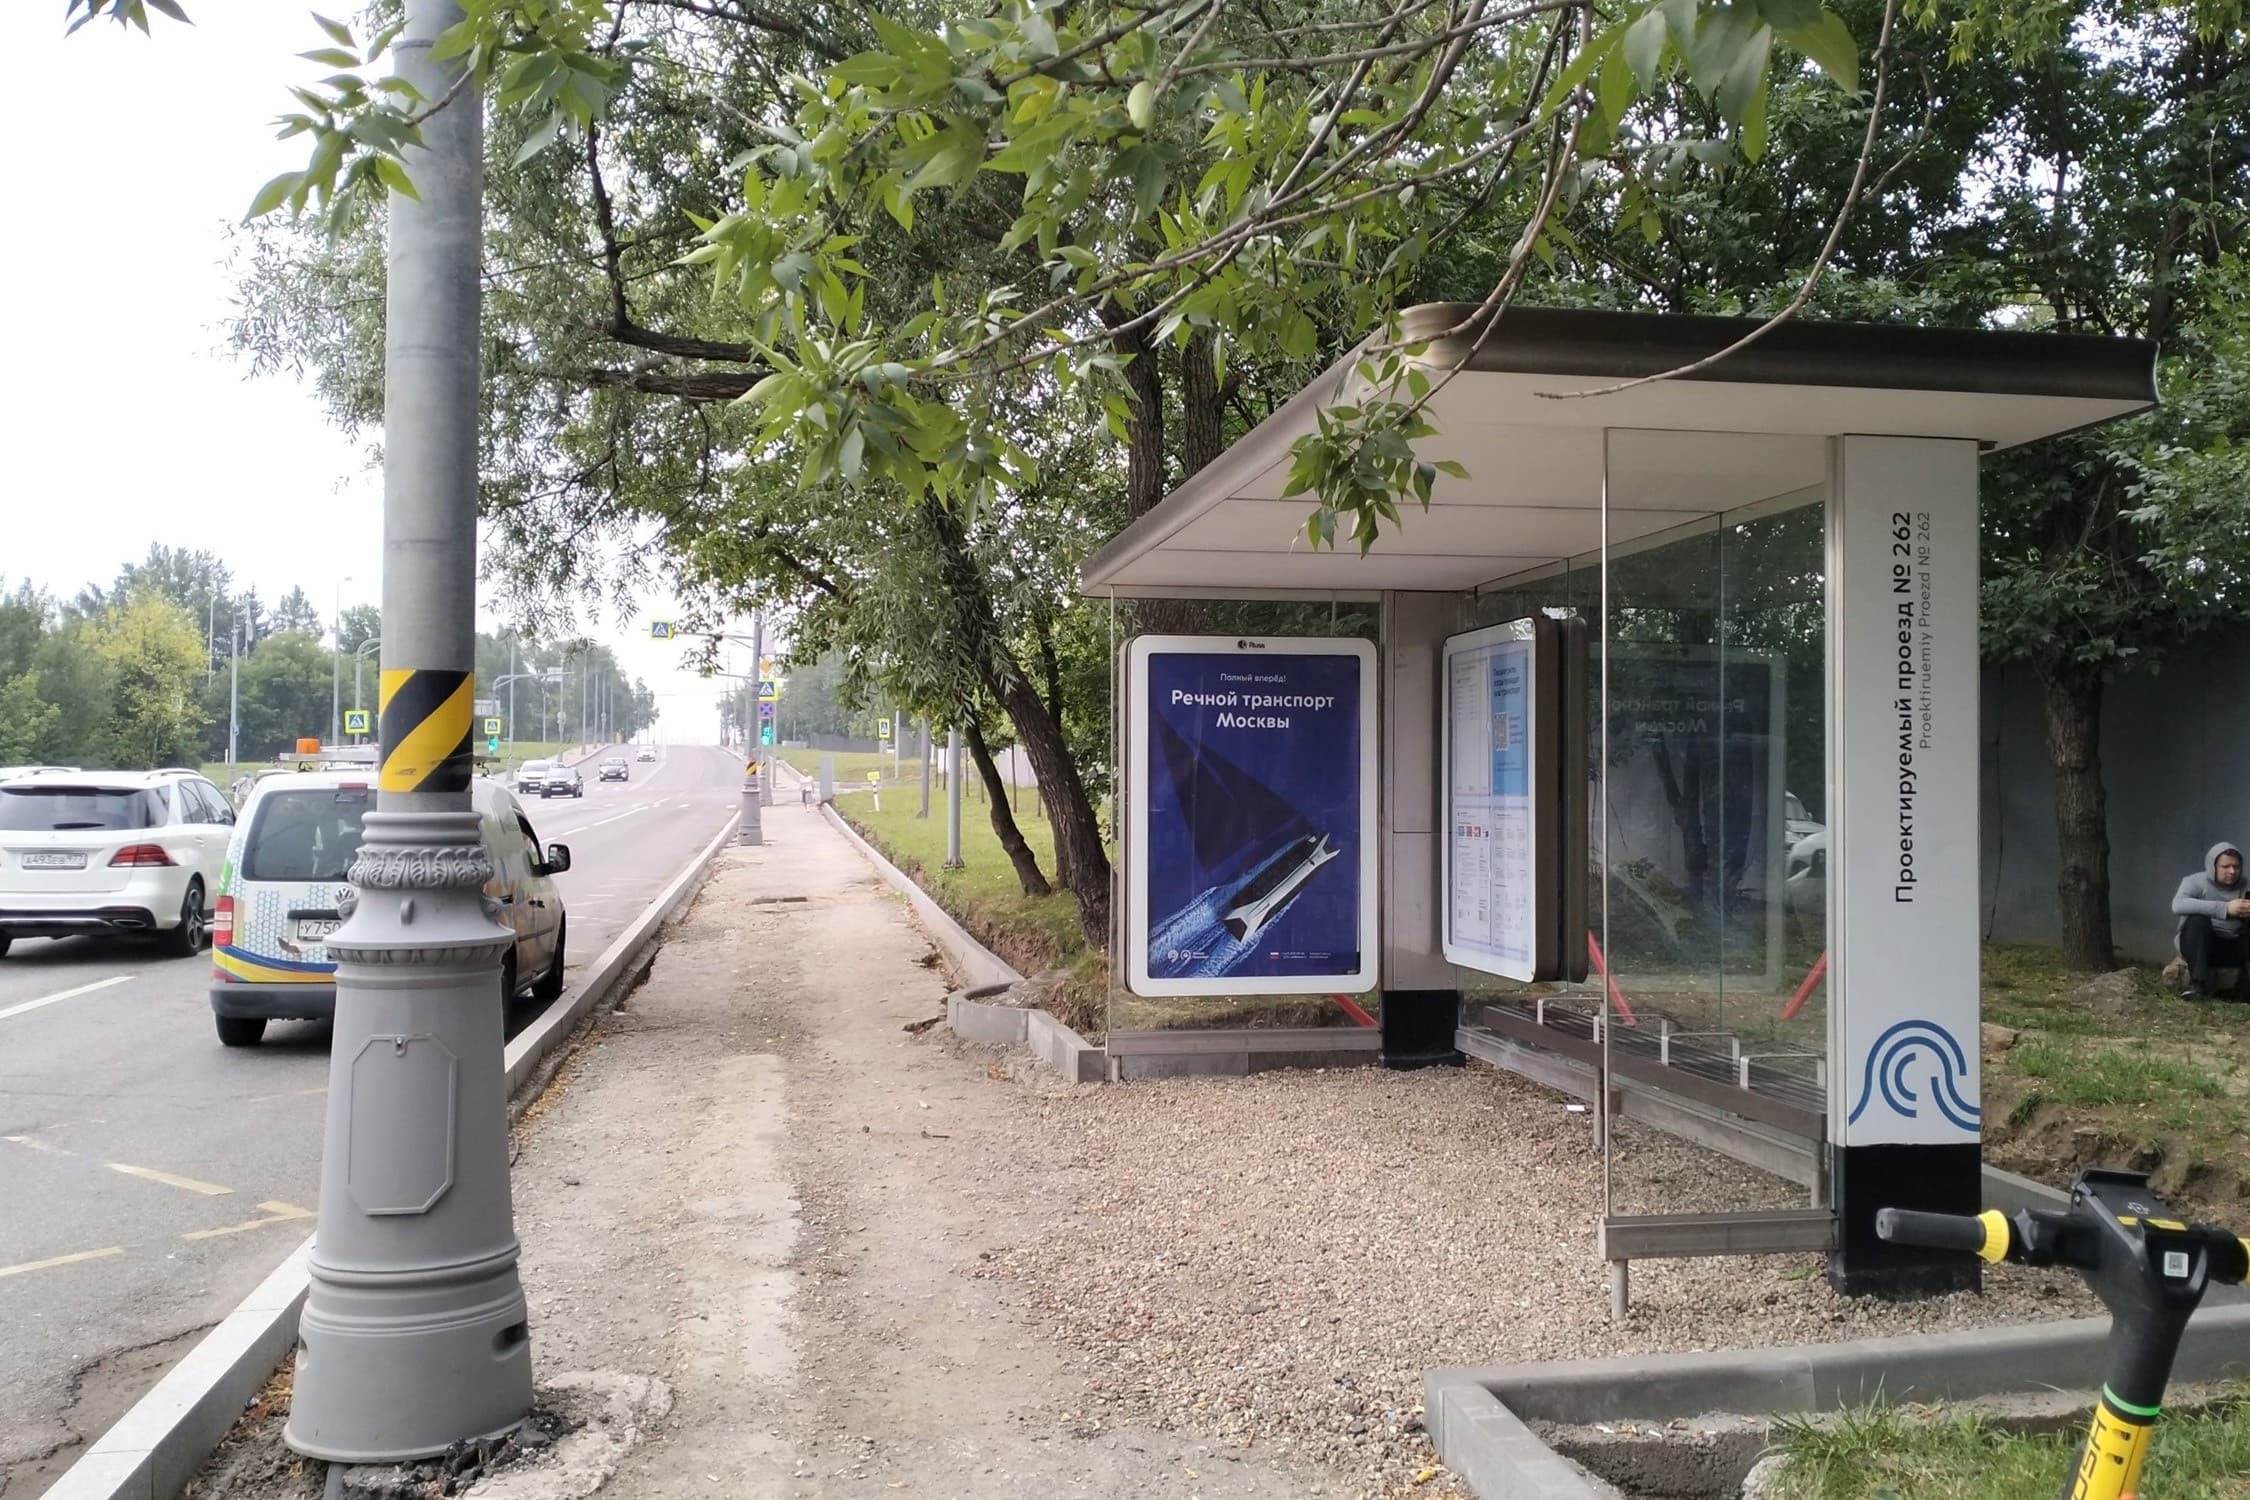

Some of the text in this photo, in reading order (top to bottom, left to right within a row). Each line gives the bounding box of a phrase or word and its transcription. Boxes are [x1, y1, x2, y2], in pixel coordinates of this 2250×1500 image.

[1917, 511, 1930, 542] 262
[1918, 572, 1931, 628] Proezd
[1219, 673, 1287, 683] Полный вперёд!
[1919, 632, 1934, 749] Proektiruemiy
[1171, 689, 1335, 711] Речной транспорт
[1892, 511, 1918, 903] Проектируемый проезд № 262
[1216, 712, 1290, 729] Москвы
